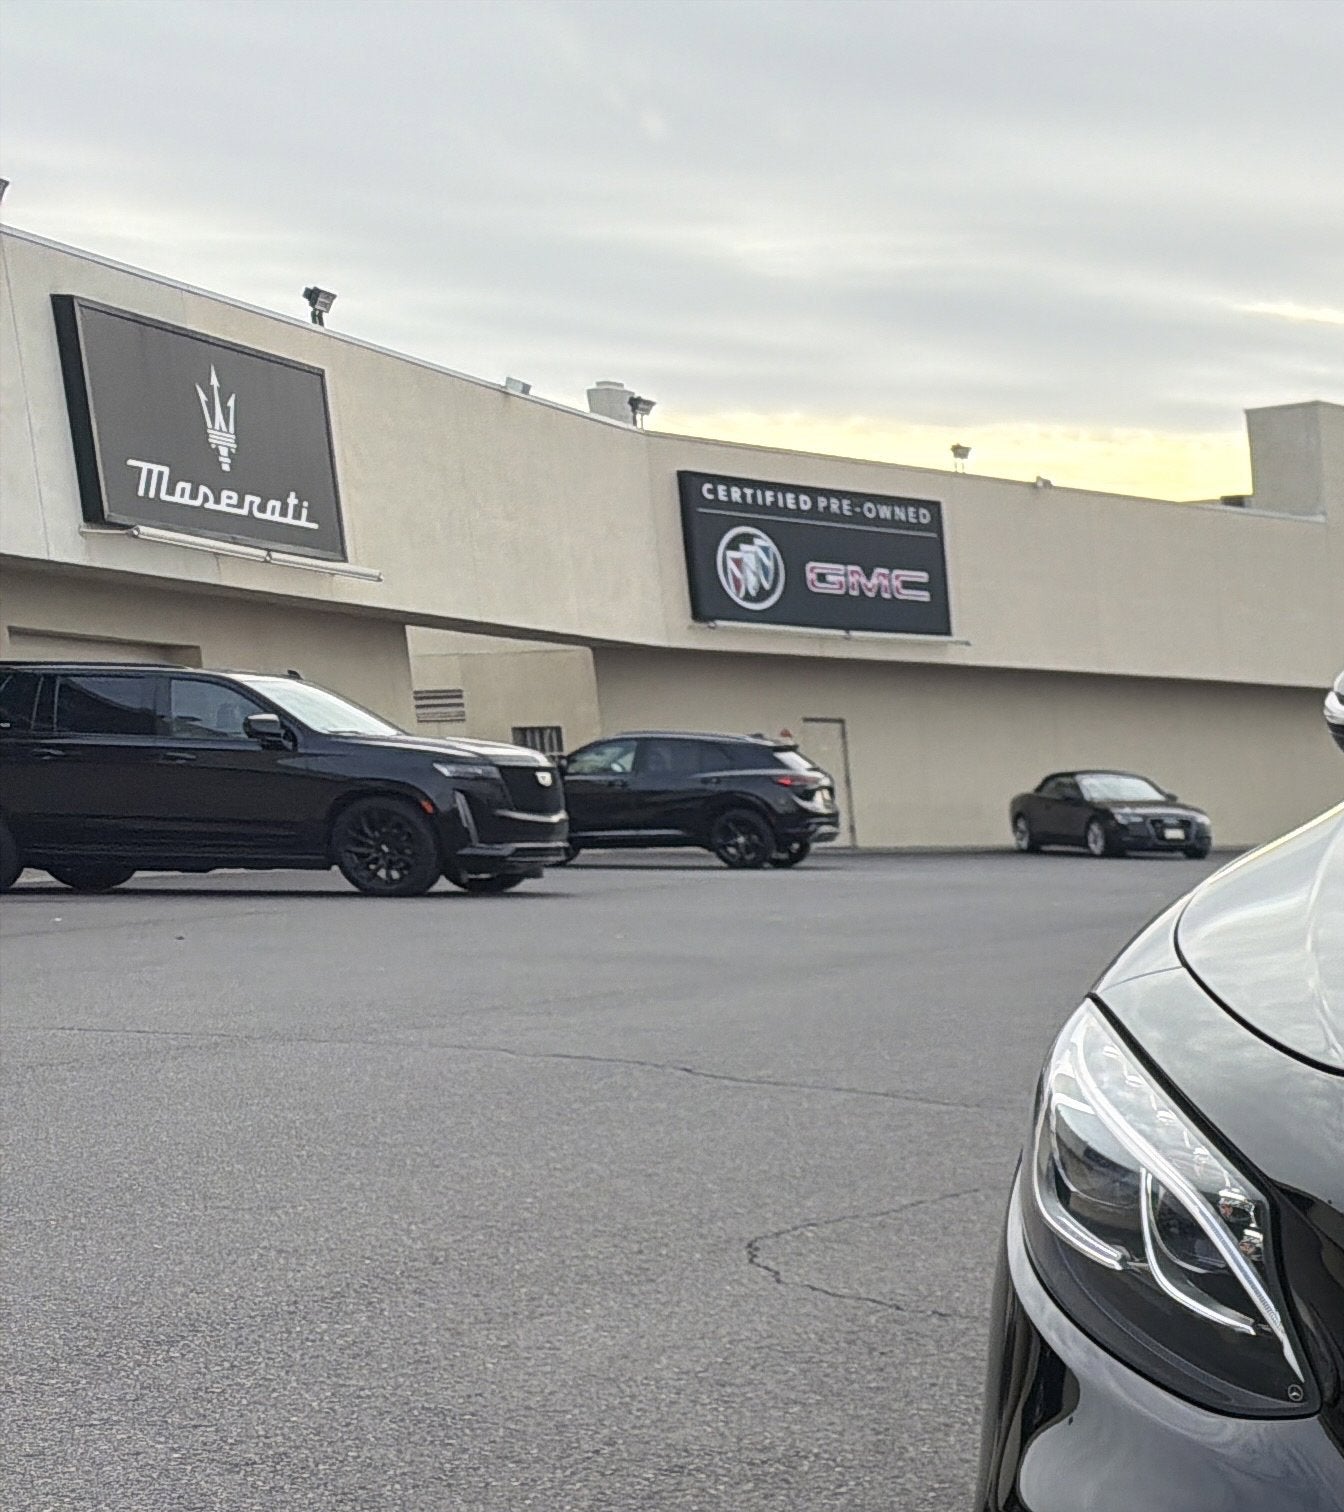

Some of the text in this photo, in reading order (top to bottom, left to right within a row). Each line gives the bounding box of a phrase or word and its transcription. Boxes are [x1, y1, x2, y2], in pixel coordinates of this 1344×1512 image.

[127, 458, 319, 530] Maserati
[701, 482, 932, 525] CERTIFIED PRE-OWNED
[805, 561, 932, 602] GMC
